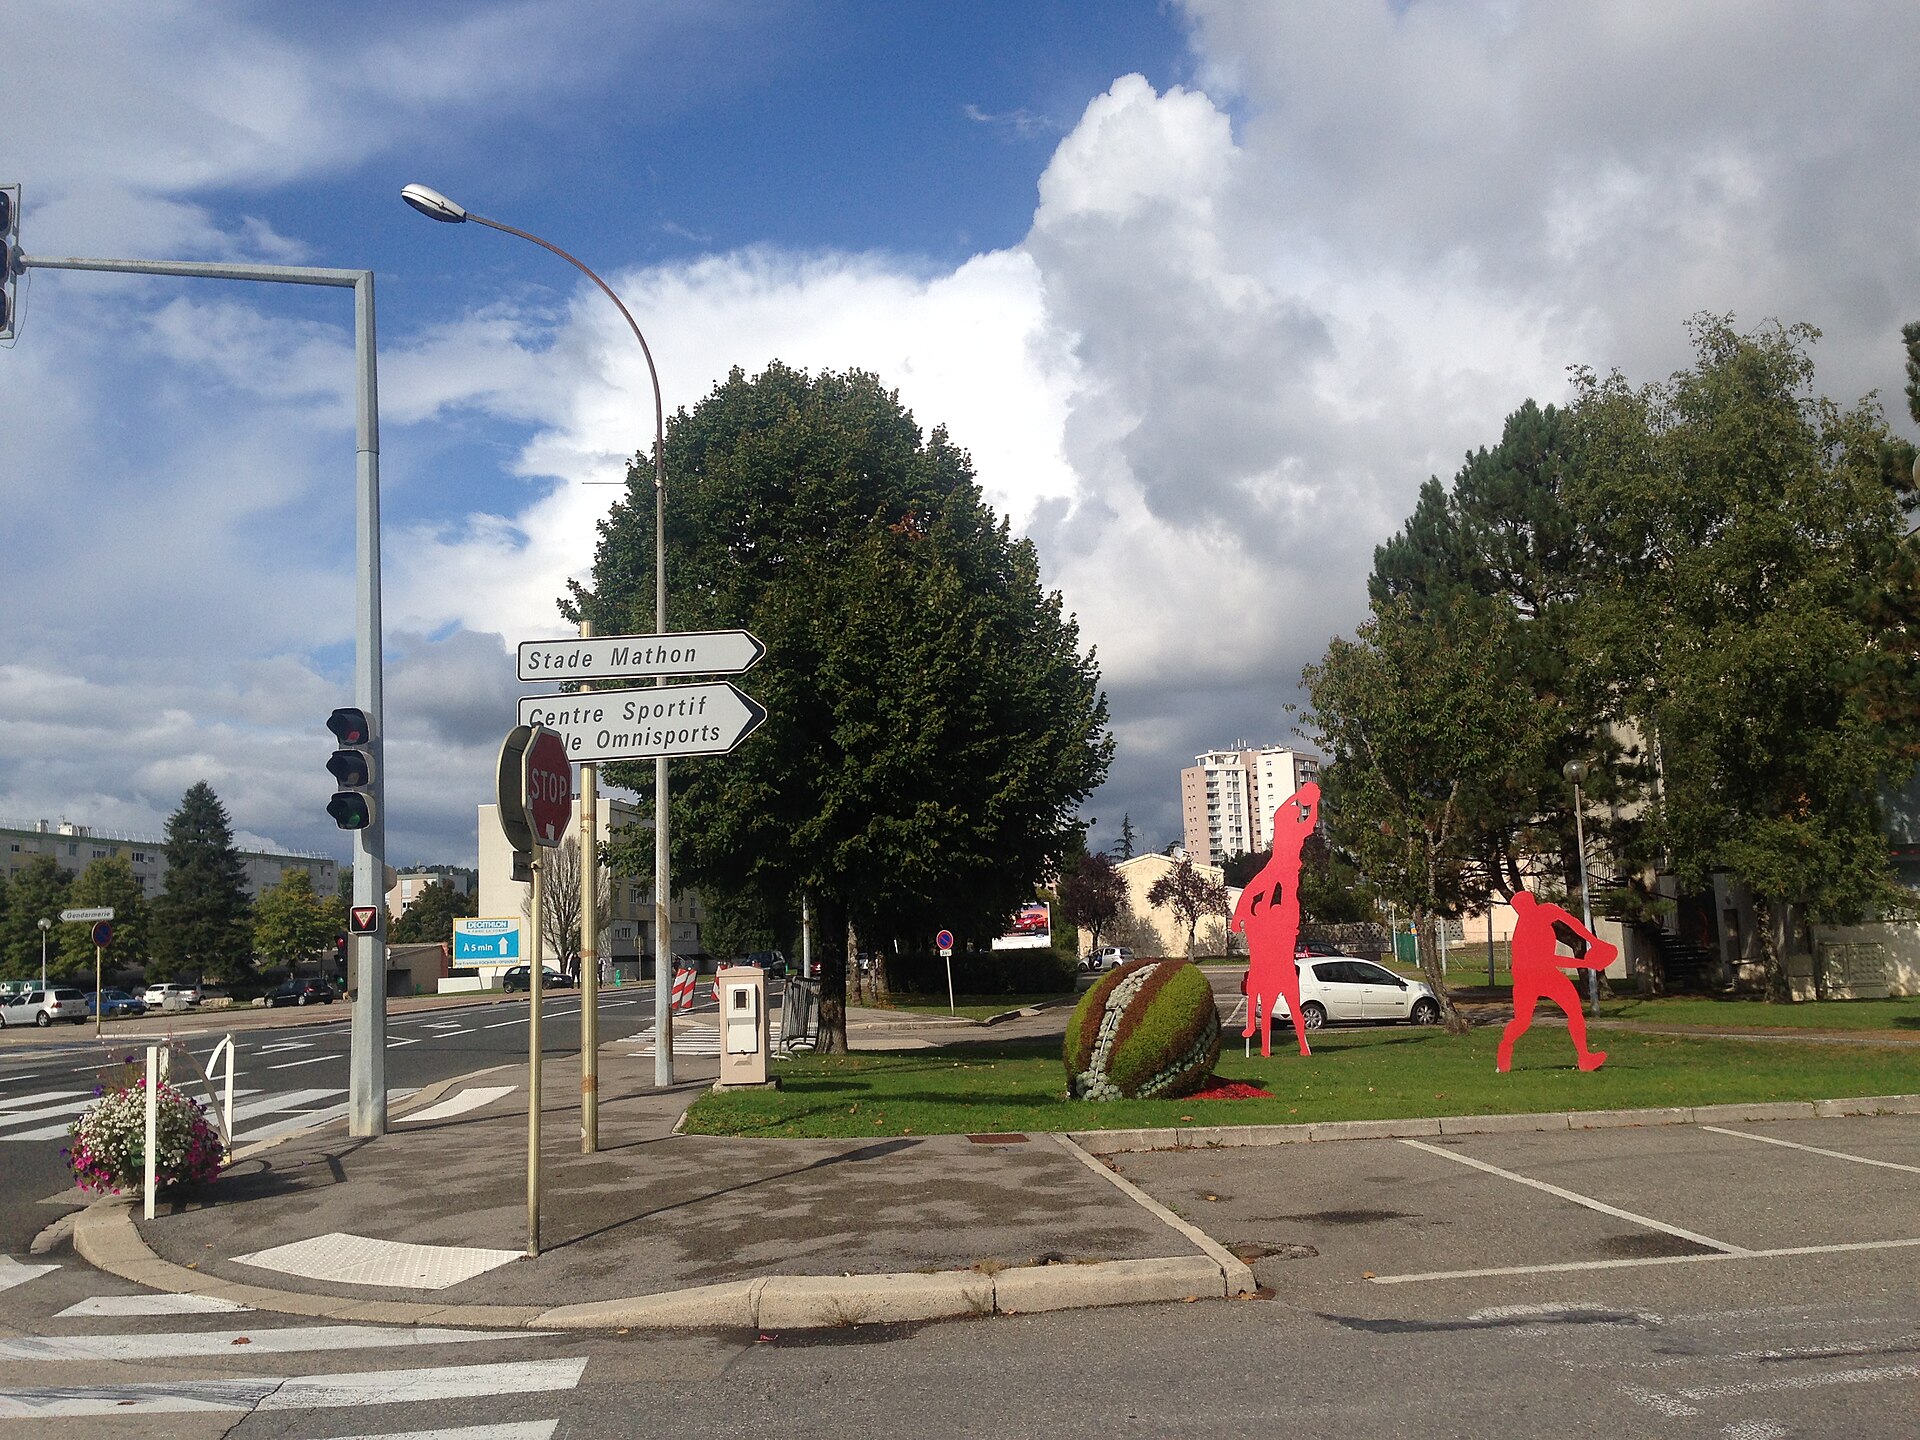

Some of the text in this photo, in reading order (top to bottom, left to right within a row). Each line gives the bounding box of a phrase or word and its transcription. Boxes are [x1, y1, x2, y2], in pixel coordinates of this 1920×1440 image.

[528, 647, 696, 670] Stade Mathon
[529, 696, 708, 726] Centre Sportif
[596, 726, 720, 749] Omnisports
[531, 768, 568, 805] STOP
[467, 921, 507, 929] DECATHLON
